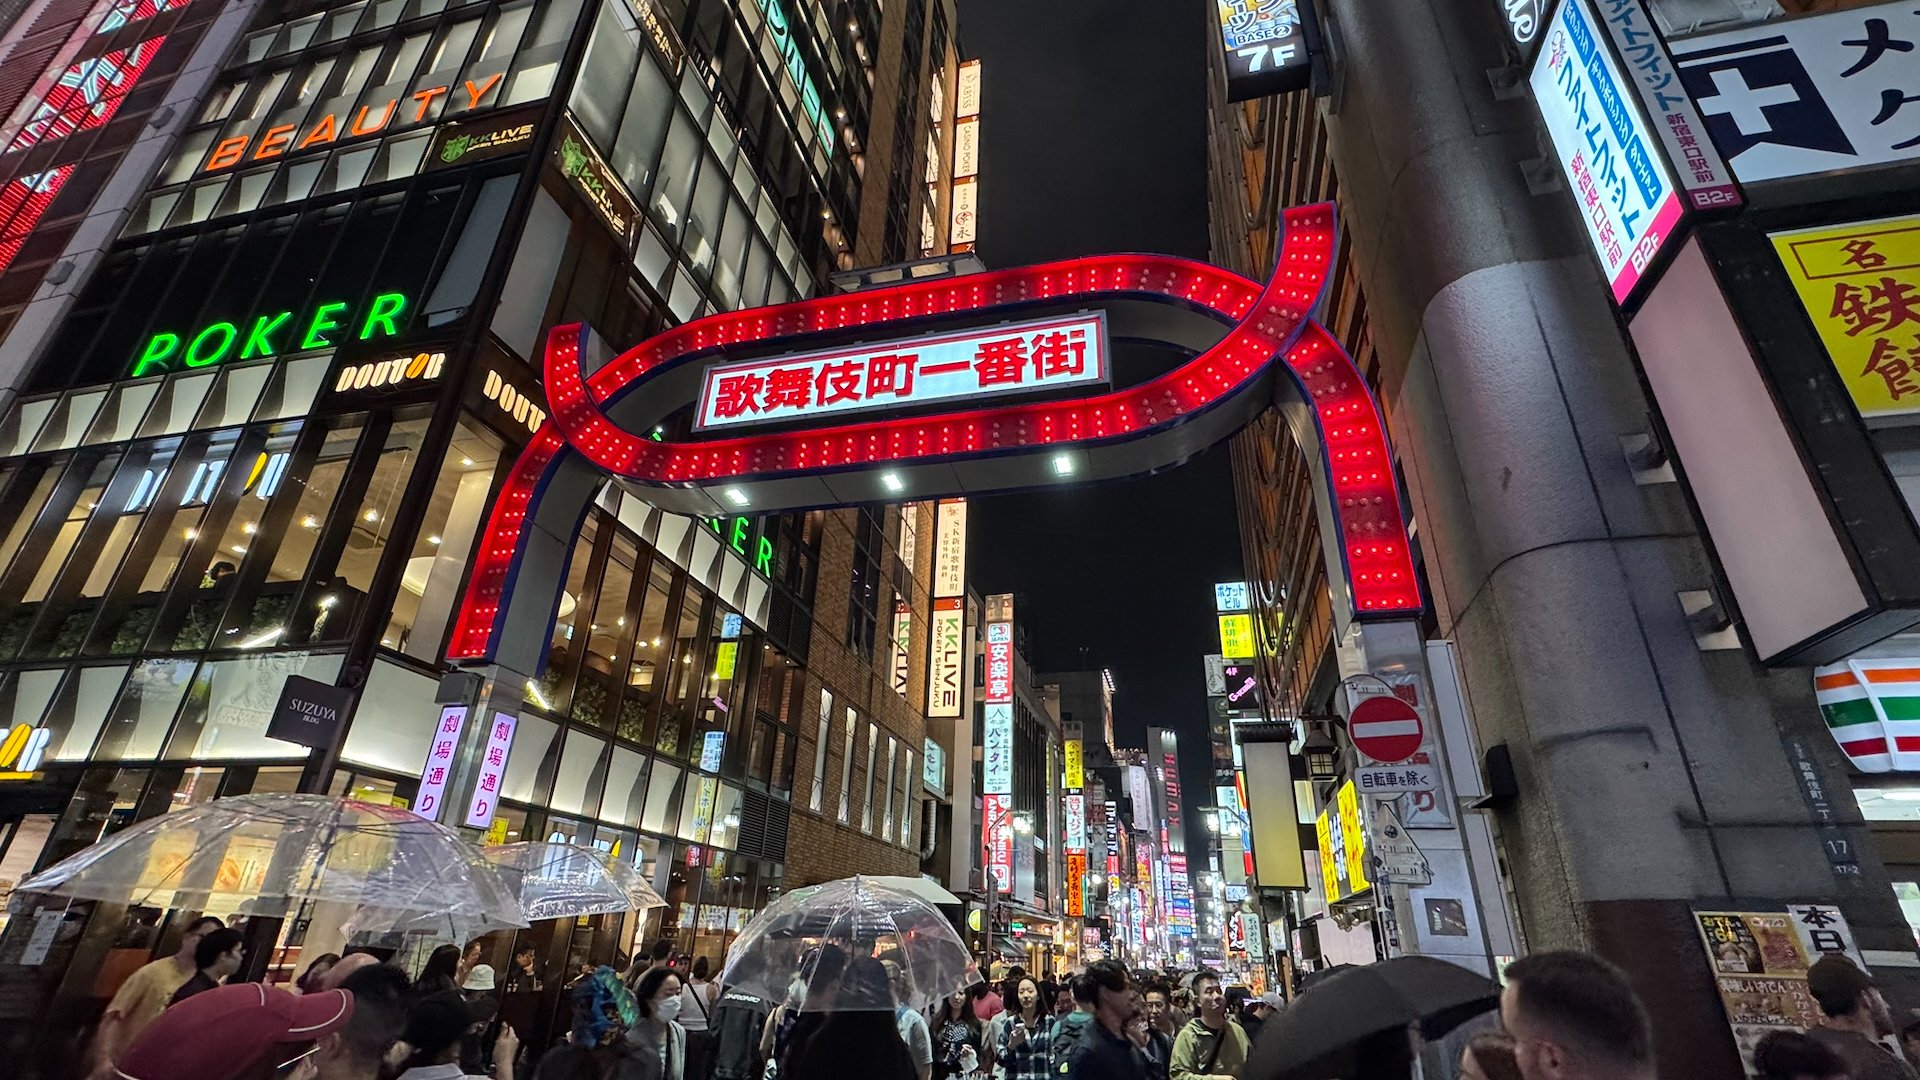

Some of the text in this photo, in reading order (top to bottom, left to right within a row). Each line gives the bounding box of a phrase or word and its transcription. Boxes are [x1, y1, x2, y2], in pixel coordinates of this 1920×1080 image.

[1237, 44, 1295, 73] 7F
[206, 74, 503, 171] BEAUTY
[469, 124, 534, 147] KKLIVE
[1559, 57, 1640, 241] ファイトフィット
[1665, 113, 1715, 183] 新宿東口駅前
[1570, 149, 1623, 269] 新宿東口駅前
[1695, 190, 1735, 206] B2F
[1630, 232, 1660, 275] B2F
[131, 293, 407, 378] POKER
[335, 352, 447, 393] DOUTOR
[714, 329, 1088, 419] 歌舞伎町一番街
[954, 599, 961, 609] 3
[1217, 585, 1245, 597] ポケット
[1224, 598, 1241, 609] ビル
[933, 618, 943, 708] POKER SHINJUKU
[943, 617, 959, 707] KKLIVE
[990, 644, 1009, 697] 安楽亭
[289, 699, 337, 722] SUZUYA
[303, 715, 320, 725] BLDG
[421, 714, 461, 812] 劇場通り
[475, 722, 510, 817] 劇場通り
[988, 728, 1001, 775] バンタイ
[1361, 770, 1429, 788] 自転車を除く
[1826, 840, 1848, 855] 17
[1836, 865, 1860, 875] 17-2
